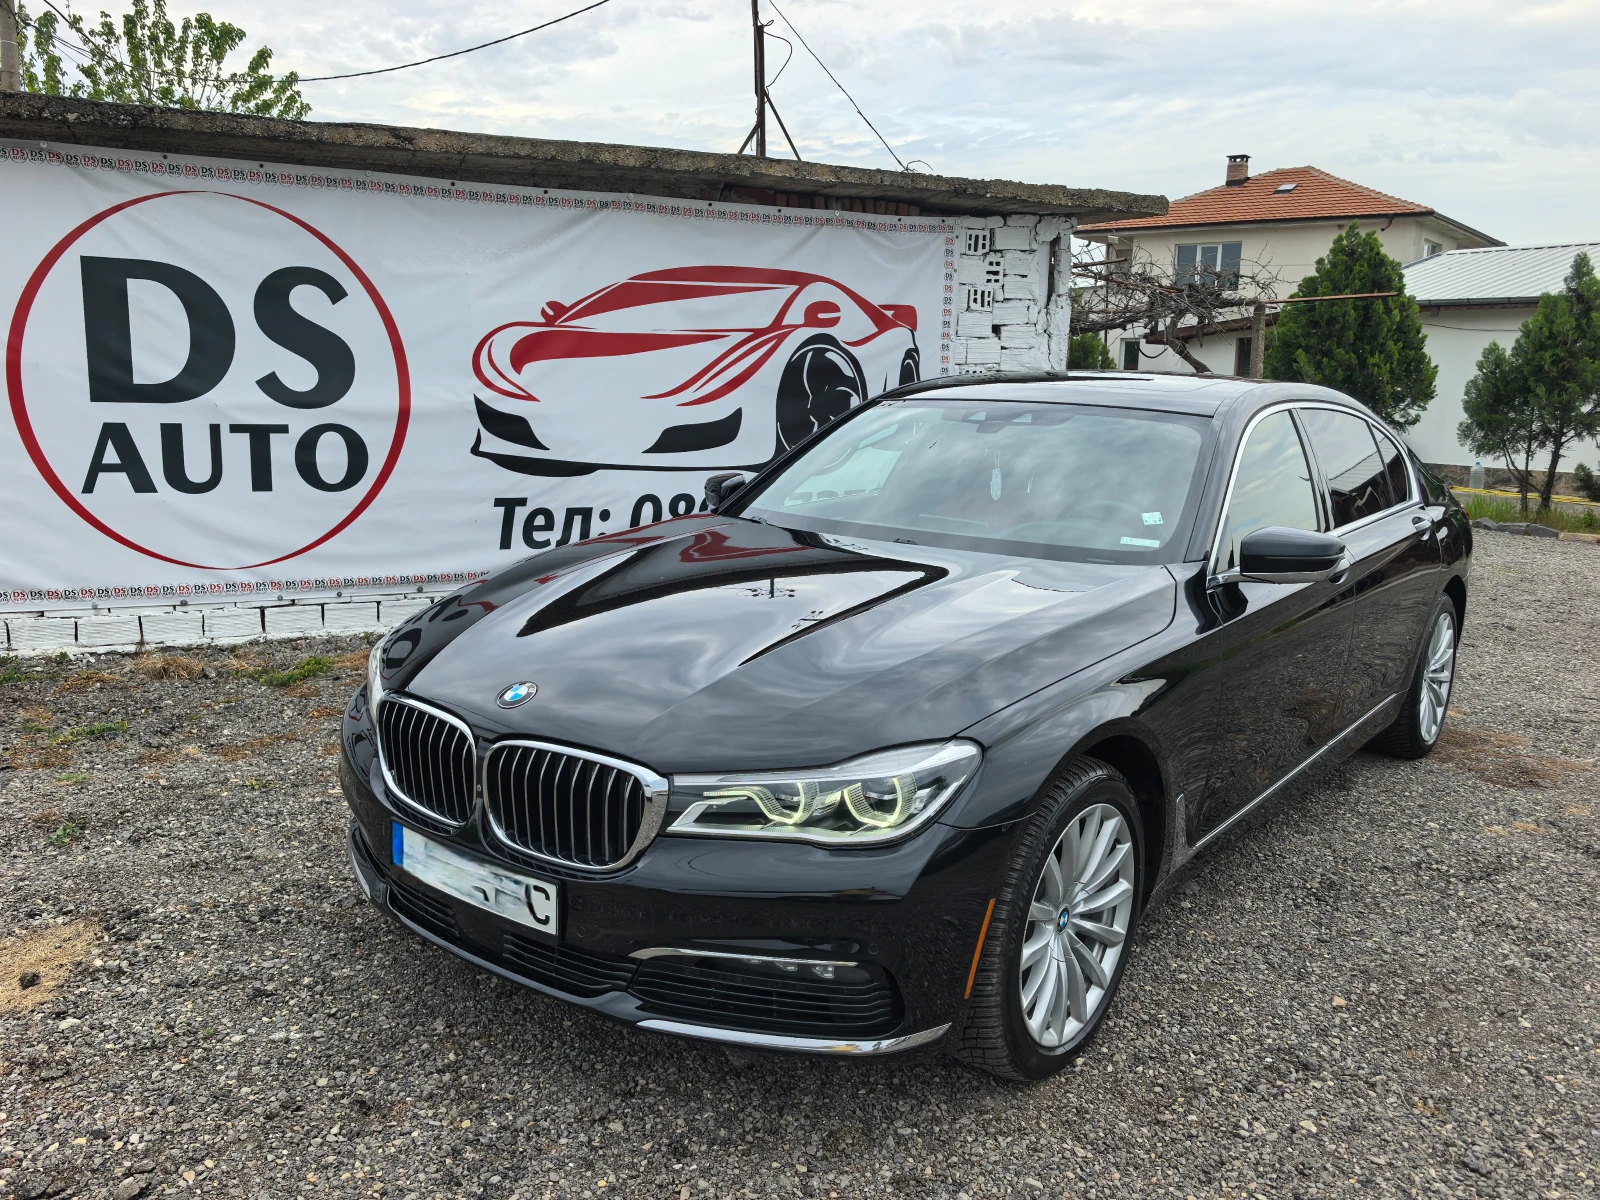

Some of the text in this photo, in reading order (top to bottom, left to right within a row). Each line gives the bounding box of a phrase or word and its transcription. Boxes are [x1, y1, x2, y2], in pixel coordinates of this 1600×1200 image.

[11, 147, 25, 156] DS
[30, 149, 43, 158] DS
[48, 151, 60, 159] DS
[66, 153, 78, 162] DS
[83, 155, 95, 163] DS
[100, 157, 112, 165] DS
[118, 158, 130, 167] DS
[135, 160, 147, 168] DS
[151, 162, 163, 170] DS
[168, 163, 180, 171] DS
[185, 165, 196, 173] DS
[201, 166, 212, 174] DS
[217, 167, 228, 175] DS
[233, 169, 244, 177] DS
[249, 170, 260, 178] DS
[280, 173, 291, 181] DS
[296, 174, 306, 182] DS
[311, 175, 322, 183] DS
[356, 179, 366, 187] DS
[370, 180, 380, 188] DS
[399, 183, 409, 191] DS
[427, 186, 437, 194] DS
[482, 191, 492, 199] DS
[548, 196, 557, 204] DS
[561, 197, 570, 205] DS
[574, 198, 583, 206] DS
[80, 255, 355, 409] DS
[81, 422, 369, 495] AUTO
[493, 497, 611, 549] Тел:
